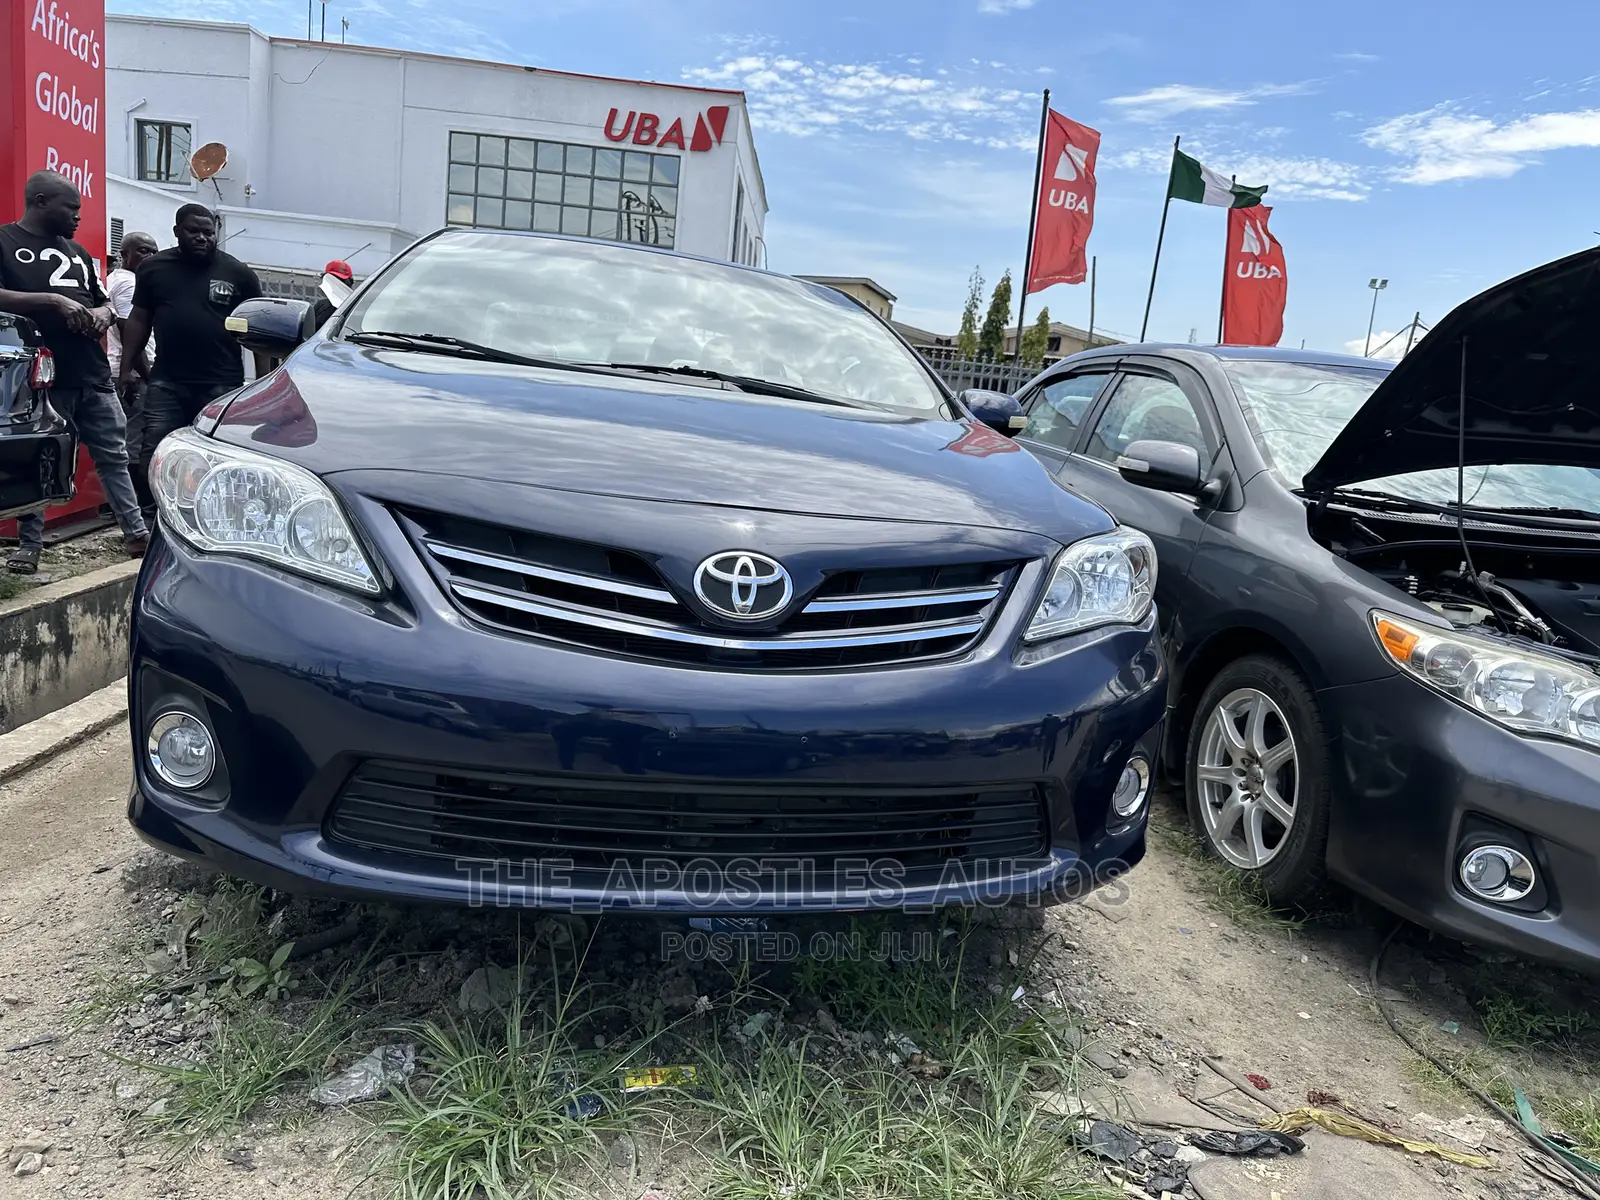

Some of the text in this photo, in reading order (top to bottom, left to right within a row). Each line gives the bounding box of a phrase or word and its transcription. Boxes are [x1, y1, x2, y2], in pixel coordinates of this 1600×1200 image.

[31, 0, 100, 69] Africa's
[35, 71, 99, 135] Global
[603, 107, 686, 151] UBA
[1048, 188, 1089, 215] UBA
[1236, 261, 1283, 280] UBA
